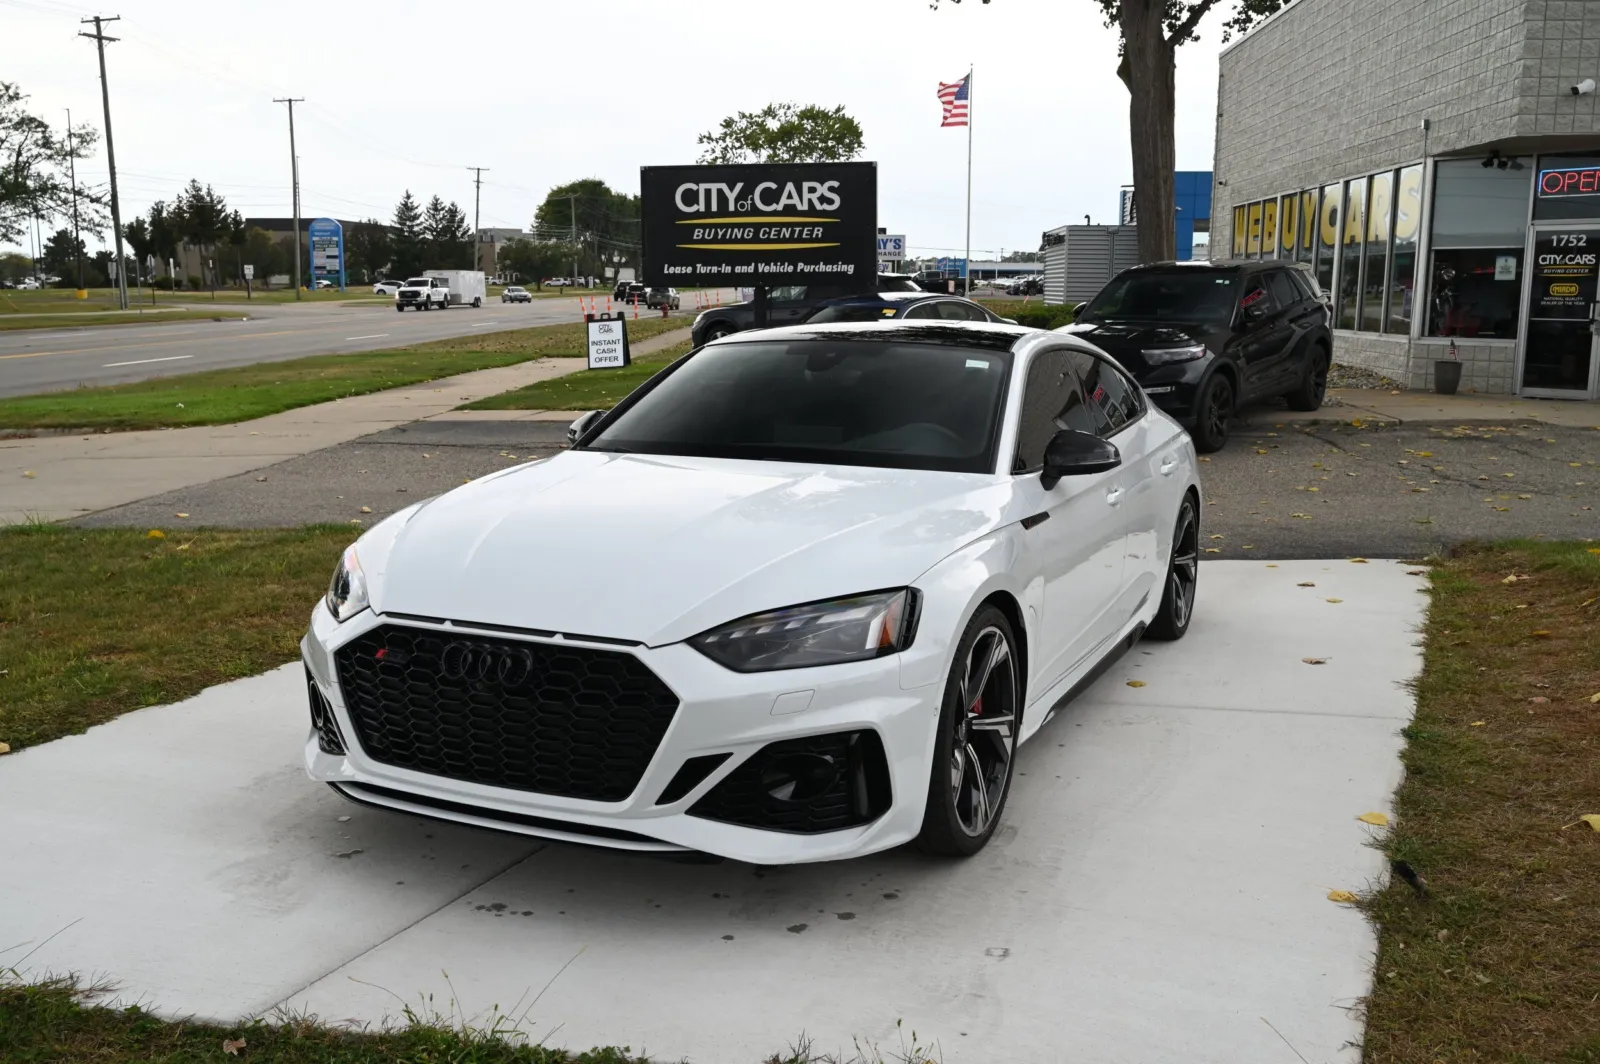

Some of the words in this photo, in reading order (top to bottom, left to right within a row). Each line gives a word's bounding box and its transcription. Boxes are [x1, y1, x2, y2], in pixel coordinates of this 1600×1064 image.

[674, 182, 745, 213] CITY
[737, 194, 754, 212] of
[753, 180, 841, 212] CARS
[692, 227, 754, 240] BUYING
[759, 226, 824, 239] CENTER
[1551, 234, 1587, 247] 1752
[1538, 254, 1562, 265] CITY
[1565, 254, 1596, 265] CARS
[663, 264, 693, 274] Lease
[696, 263, 732, 274] Turn-In
[734, 262, 755, 273] and
[757, 262, 794, 273] Vehicle
[796, 261, 855, 275] Purchasing
[591, 339, 621, 347] INSTANT
